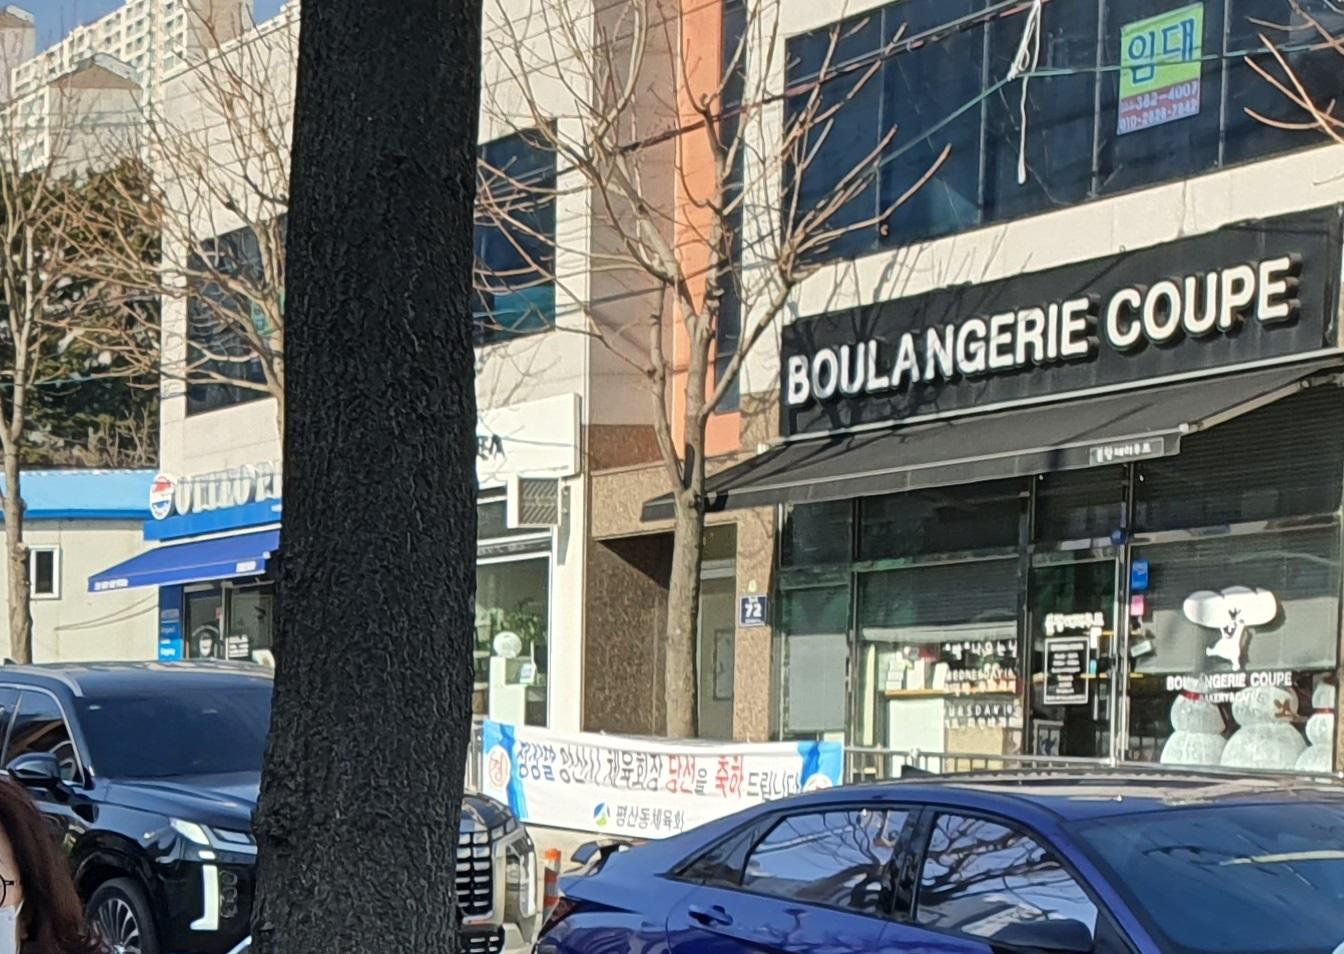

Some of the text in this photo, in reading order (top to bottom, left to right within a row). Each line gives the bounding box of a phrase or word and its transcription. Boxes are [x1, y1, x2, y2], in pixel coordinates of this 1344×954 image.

[1128, 18, 1194, 84] 임대
[787, 256, 1292, 407] BOULANGERIE COUPE
[744, 602, 762, 618] 72
[1249, 671, 1293, 687] COUPE
[559, 744, 602, 787] 양산시
[607, 748, 664, 792] 체육회장
[665, 754, 709, 797] 당선을
[715, 754, 745, 798] 축하
[746, 770, 801, 801] 드립니다
[615, 803, 686, 833] 평산동체육회
